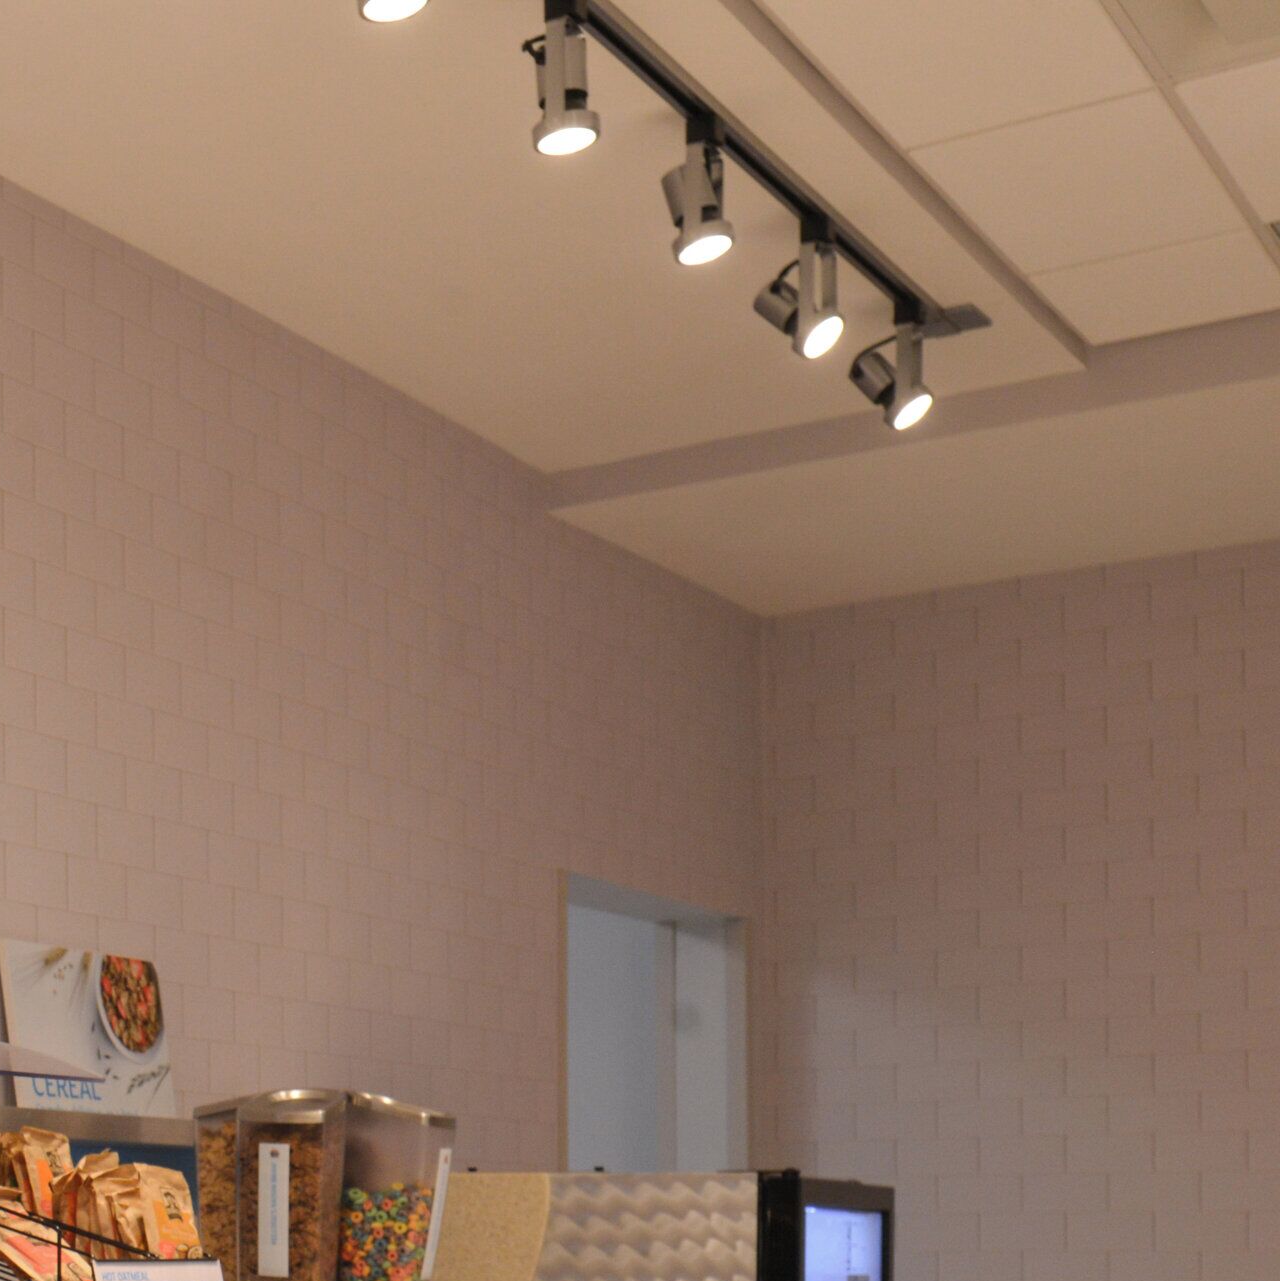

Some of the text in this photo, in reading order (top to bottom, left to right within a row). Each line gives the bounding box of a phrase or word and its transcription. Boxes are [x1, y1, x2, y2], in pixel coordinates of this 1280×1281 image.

[31, 1077, 102, 1101] CEREAL
[102, 1271, 149, 1281] HOT OATMEAL
